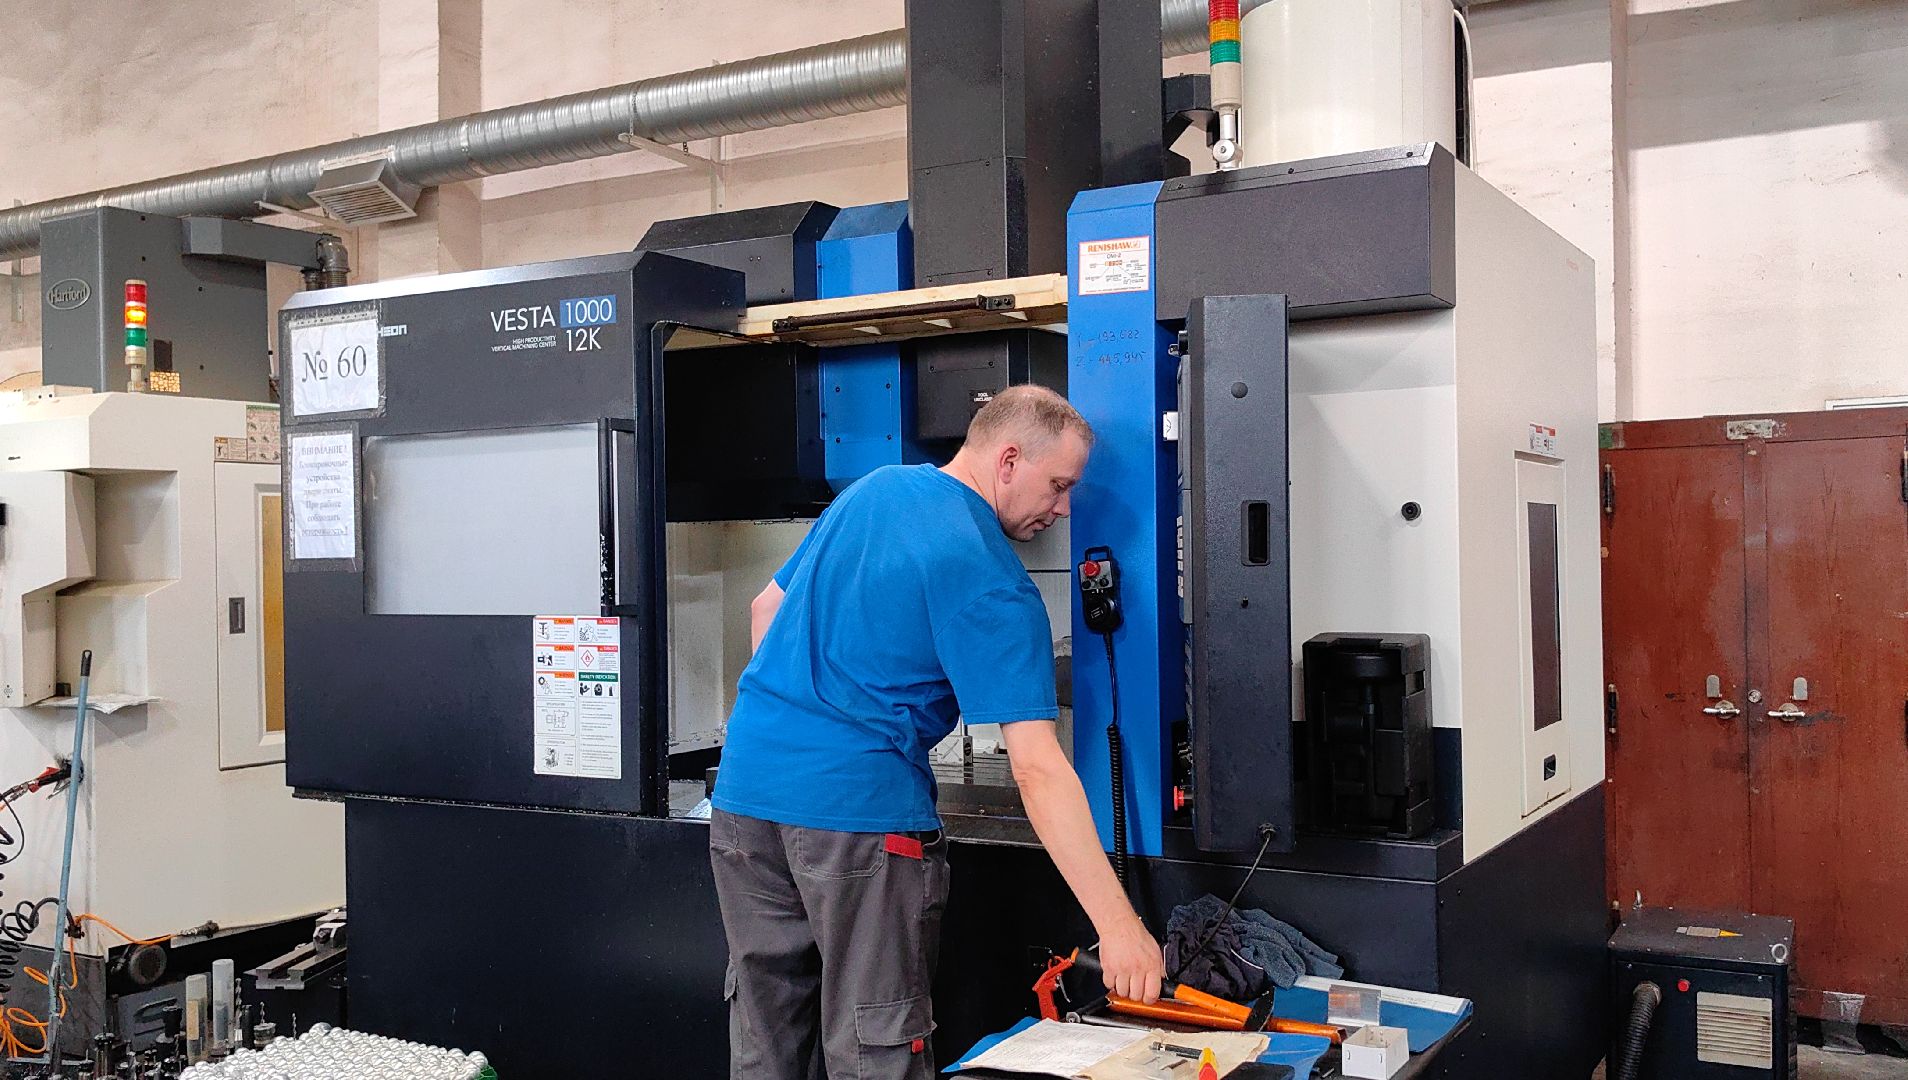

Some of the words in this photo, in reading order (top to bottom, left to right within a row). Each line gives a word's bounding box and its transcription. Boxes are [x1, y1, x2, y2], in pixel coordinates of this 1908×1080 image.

[50, 285, 87, 303] Hartford
[490, 304, 557, 333] VESTA
[565, 298, 612, 324] 1000
[538, 340, 557, 348] CENTER
[565, 326, 602, 352] 12K
[338, 345, 367, 378] 60
